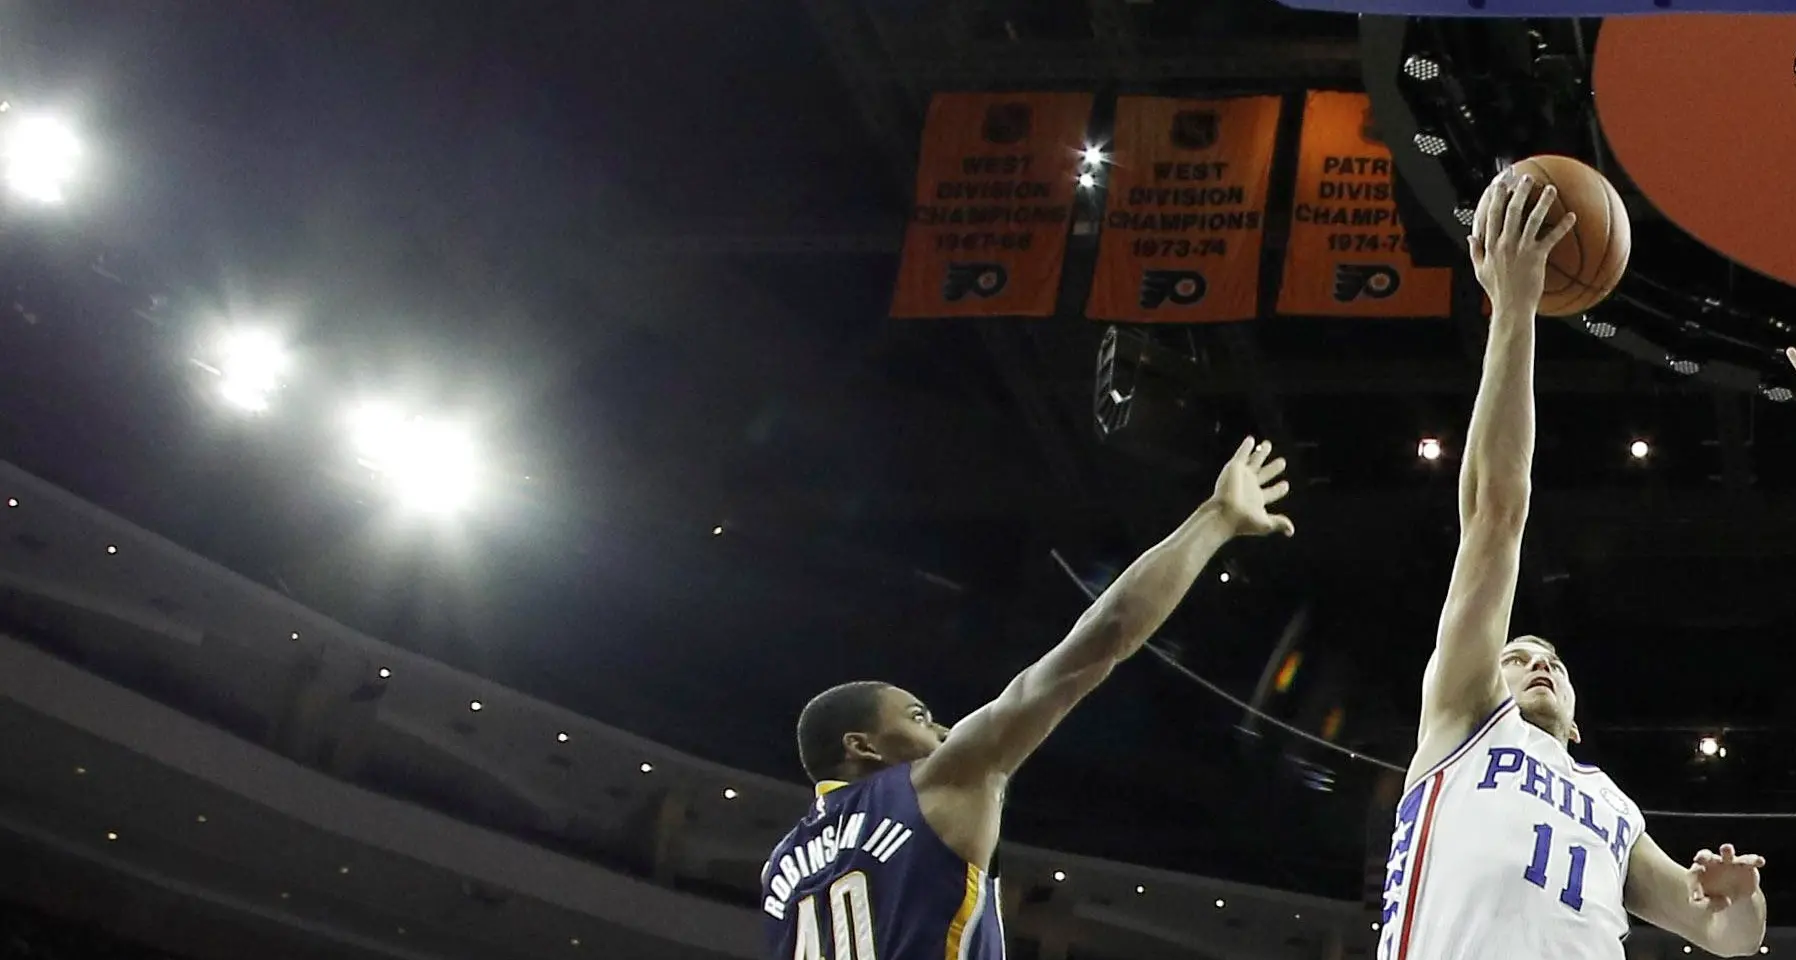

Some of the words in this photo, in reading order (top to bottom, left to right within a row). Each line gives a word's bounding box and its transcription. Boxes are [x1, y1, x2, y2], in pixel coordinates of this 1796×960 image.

[962, 156, 1033, 175] WEST
[1153, 163, 1229, 180] WEST
[937, 181, 1053, 200] DIVISION
[1129, 187, 1244, 205] DIVISION
[914, 205, 1067, 225] CHAMPIONS
[1107, 211, 1262, 230] CHAMPIONS
[1131, 239, 1227, 257] 1973-74
[763, 812, 866, 921] ROBINSN
[862, 818, 913, 863] III
[1523, 823, 1588, 912] 11
